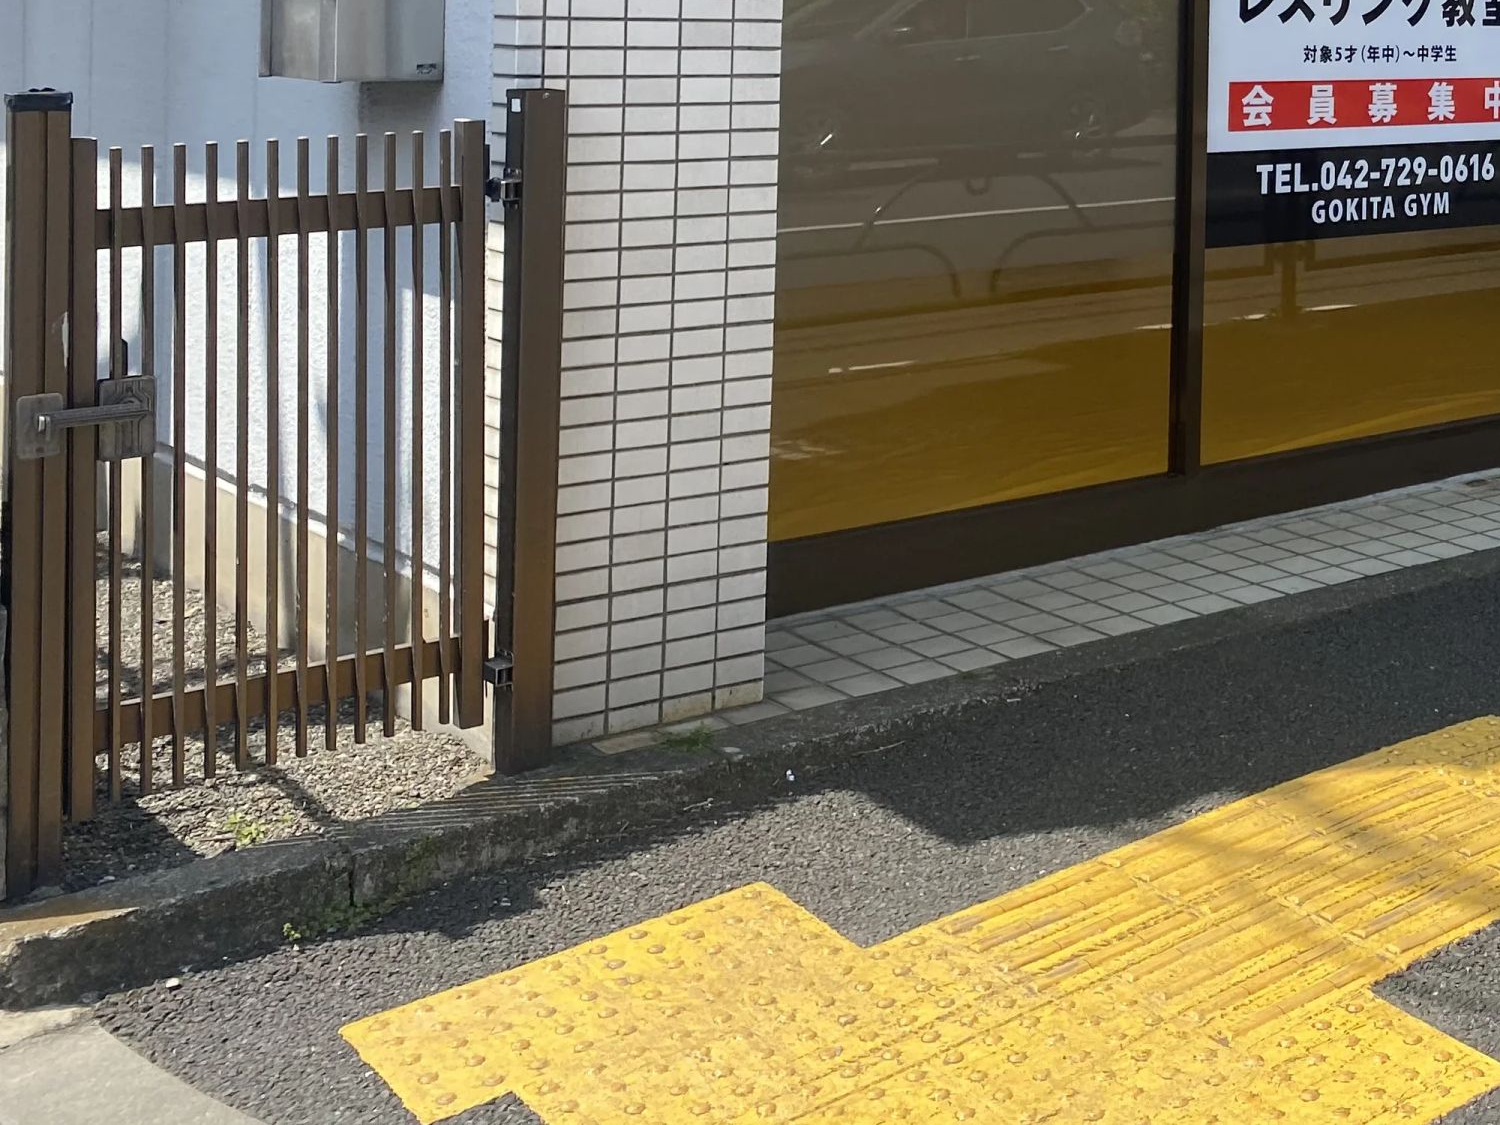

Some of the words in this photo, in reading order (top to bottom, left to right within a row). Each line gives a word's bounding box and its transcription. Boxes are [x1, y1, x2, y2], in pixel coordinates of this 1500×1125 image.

[1256, 153, 1495, 195] TEL.042-729-0616
[1311, 195, 1395, 224] GOKITA
[1404, 191, 1450, 216] GYM
